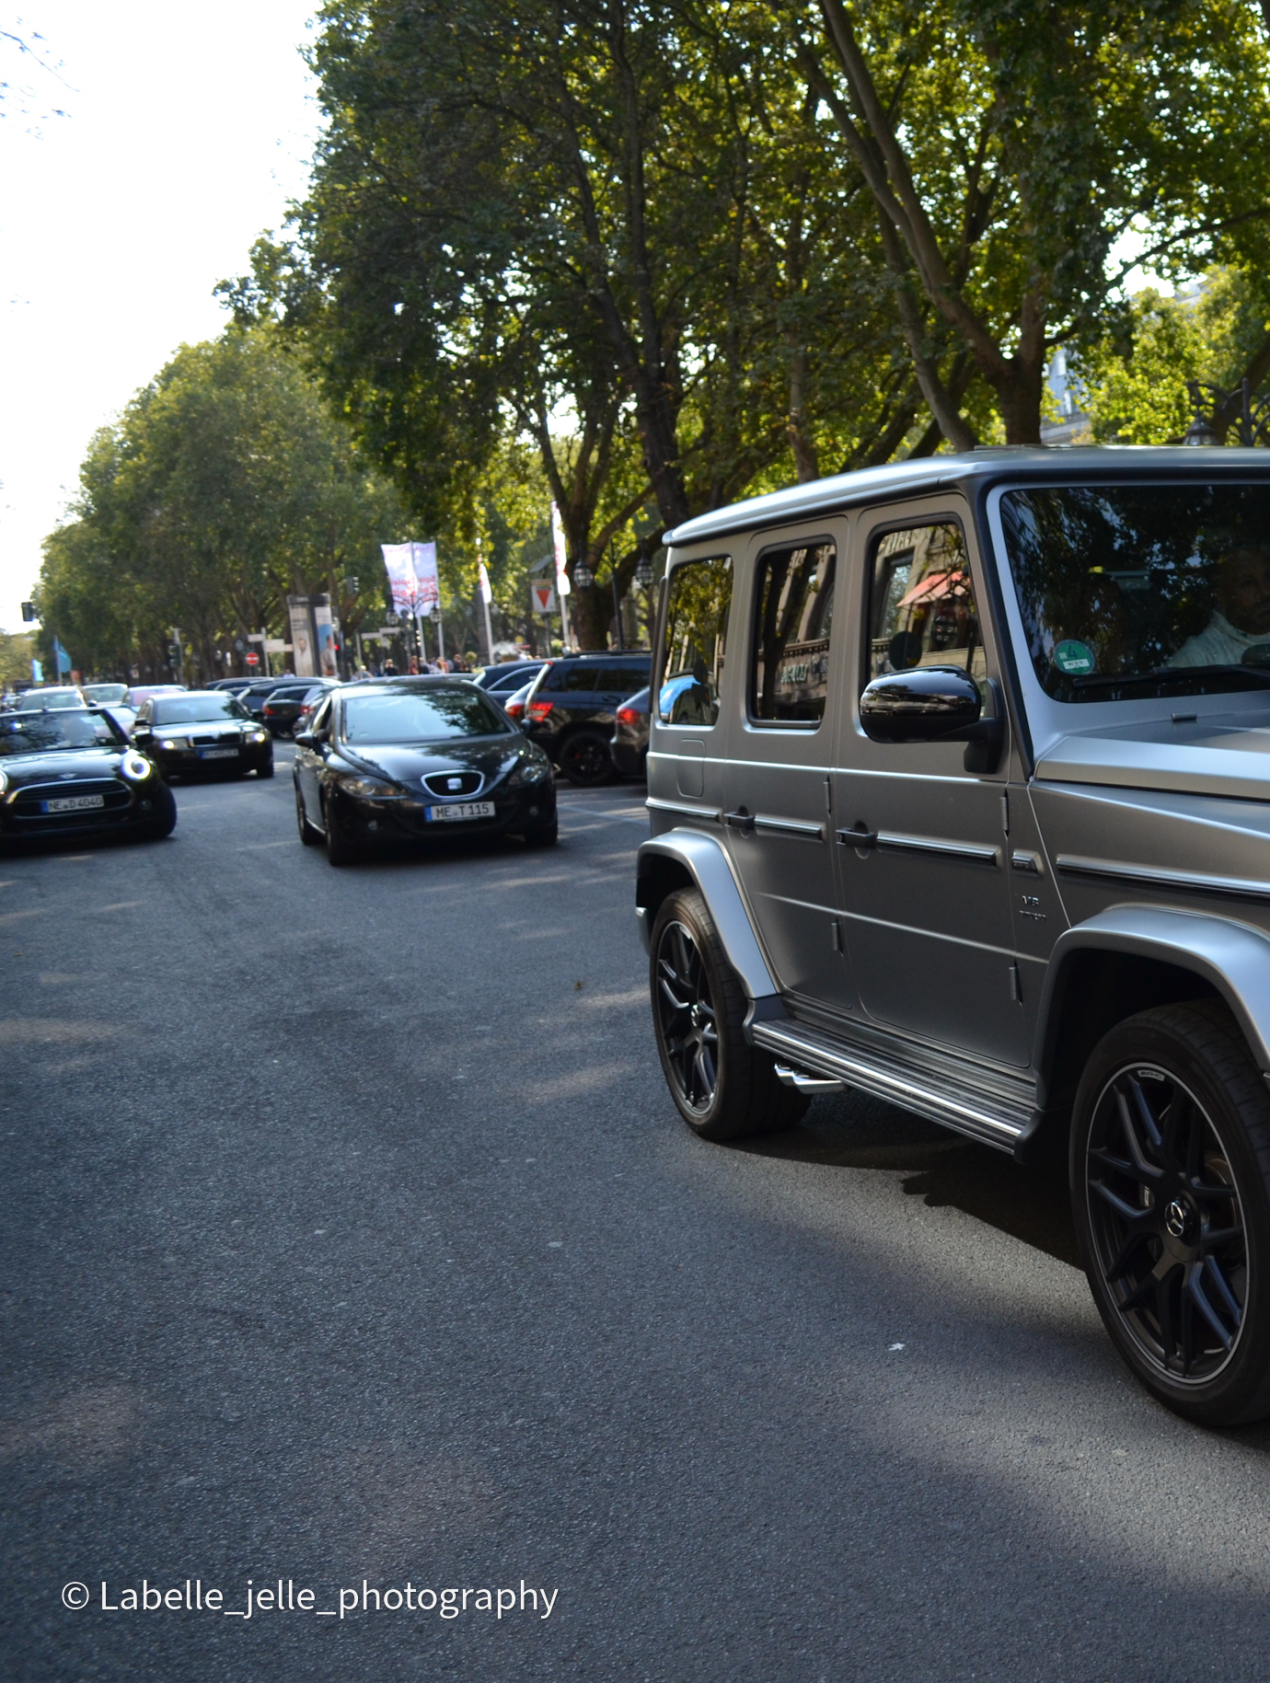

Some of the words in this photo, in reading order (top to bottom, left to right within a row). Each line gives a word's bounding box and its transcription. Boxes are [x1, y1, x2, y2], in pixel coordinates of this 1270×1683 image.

[436, 806, 451, 818] ME
[458, 805, 466, 816] T
[468, 803, 490, 815] 115
